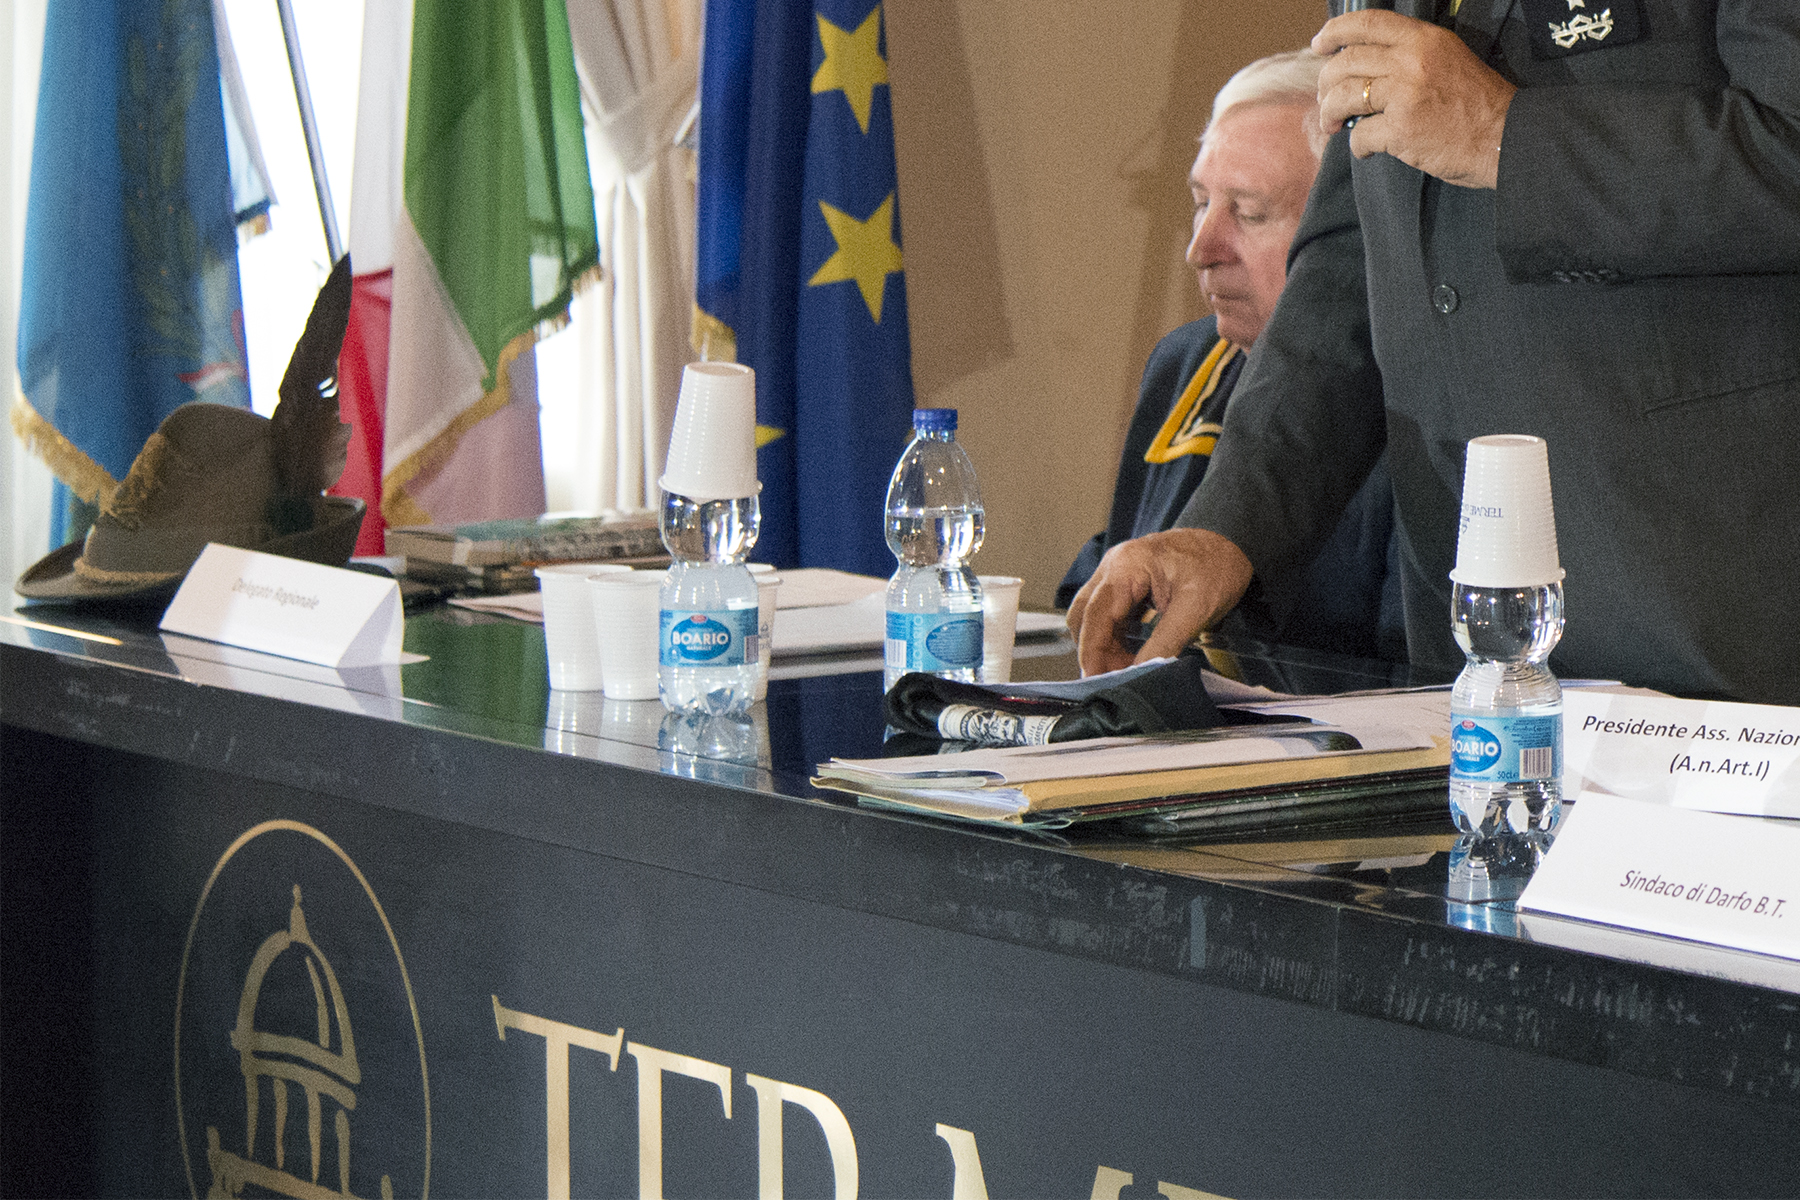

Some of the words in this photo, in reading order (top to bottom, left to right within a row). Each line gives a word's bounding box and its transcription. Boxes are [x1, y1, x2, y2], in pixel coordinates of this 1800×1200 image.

[1469, 504, 1504, 518] TERME
[231, 577, 273, 599] Delegato
[273, 586, 320, 610] Regionale
[672, 631, 729, 645] BOARIO
[1582, 715, 1688, 739] Presidente
[1692, 724, 1731, 741] Ass.
[1669, 753, 1771, 782] (A.n.Art.I)
[1620, 869, 1685, 898] Sindaco
[1686, 883, 1708, 902] di
[1705, 886, 1753, 911] Darfo
[1754, 896, 1787, 919] B.T.
